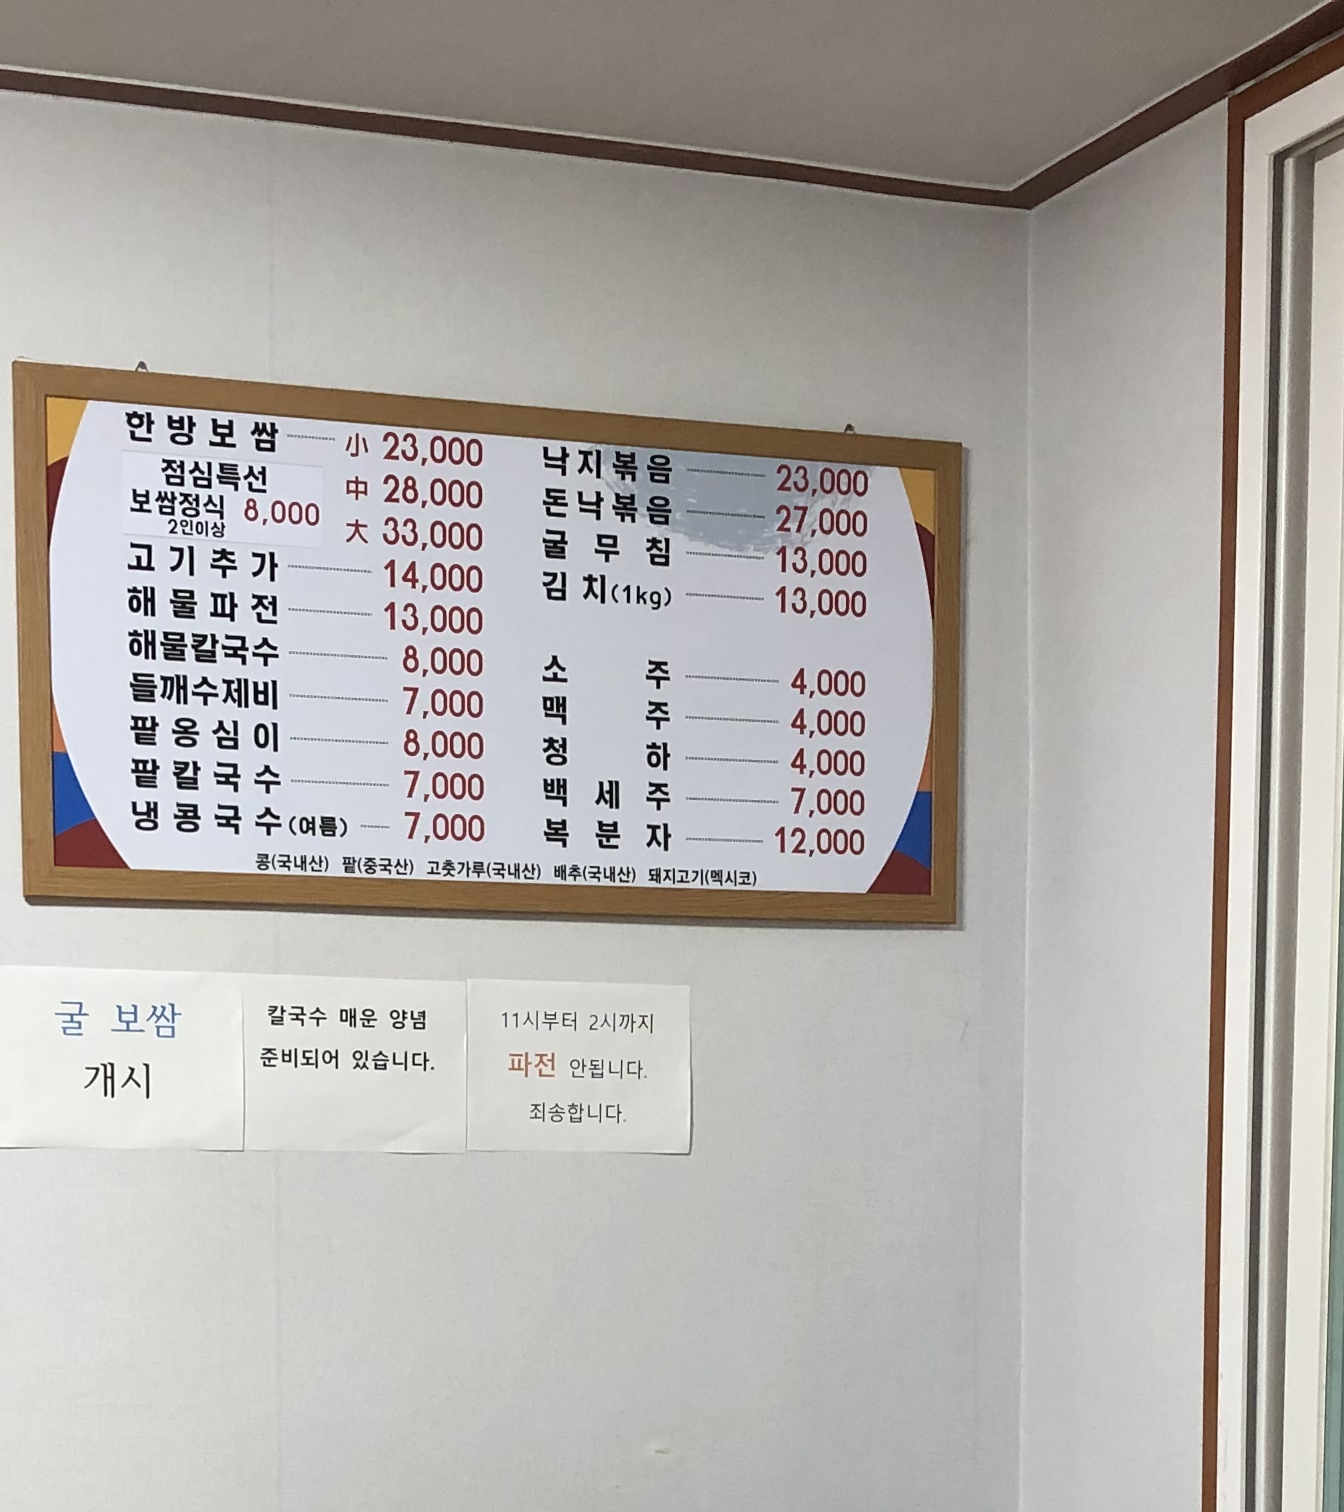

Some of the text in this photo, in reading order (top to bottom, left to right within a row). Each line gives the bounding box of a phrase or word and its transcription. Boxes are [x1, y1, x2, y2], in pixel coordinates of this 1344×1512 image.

[344, 434, 369, 457] 小
[382, 431, 484, 467] 23,000
[160, 458, 268, 493] 점심특선
[345, 474, 484, 508] 中 28,000
[775, 464, 869, 497] 23,000
[129, 489, 321, 526] 보쌈정식 8,000
[775, 505, 868, 537] 27,000
[167, 519, 226, 538] 2인이상
[345, 516, 484, 551] 大 33,000
[383, 559, 484, 593] 14,000
[775, 546, 868, 577] 13,000
[775, 586, 867, 618] 13,000
[383, 602, 484, 635] 13,000
[128, 629, 484, 677] 해물칼국수 8,000
[129, 673, 485, 719] 들깨수제비 7,000
[790, 668, 866, 698] 4,000
[790, 708, 866, 738] 4,000
[402, 730, 485, 760] 8,000
[790, 748, 866, 777] 4,000
[403, 770, 485, 802] 7,000
[790, 787, 866, 818] 7,000
[404, 812, 486, 843] 7,000
[774, 827, 866, 857] 12,000
[255, 853, 758, 887] 콩(국내산) 팥(중국산) 고춧가루(국내산) 배추(국내산) 돼지고기(멕시코)
[54, 1001, 183, 1040] 굴 보쌈
[266, 1005, 428, 1032] 칼국수 매운 양념
[500, 1010, 655, 1035] 11시부터 2시까지
[258, 1046, 436, 1073] 준비되어 있습니다.
[507, 1052, 649, 1080] 파전 안됩니다.
[83, 1062, 153, 1101] 개시
[528, 1101, 628, 1125] 죄송합니다.
